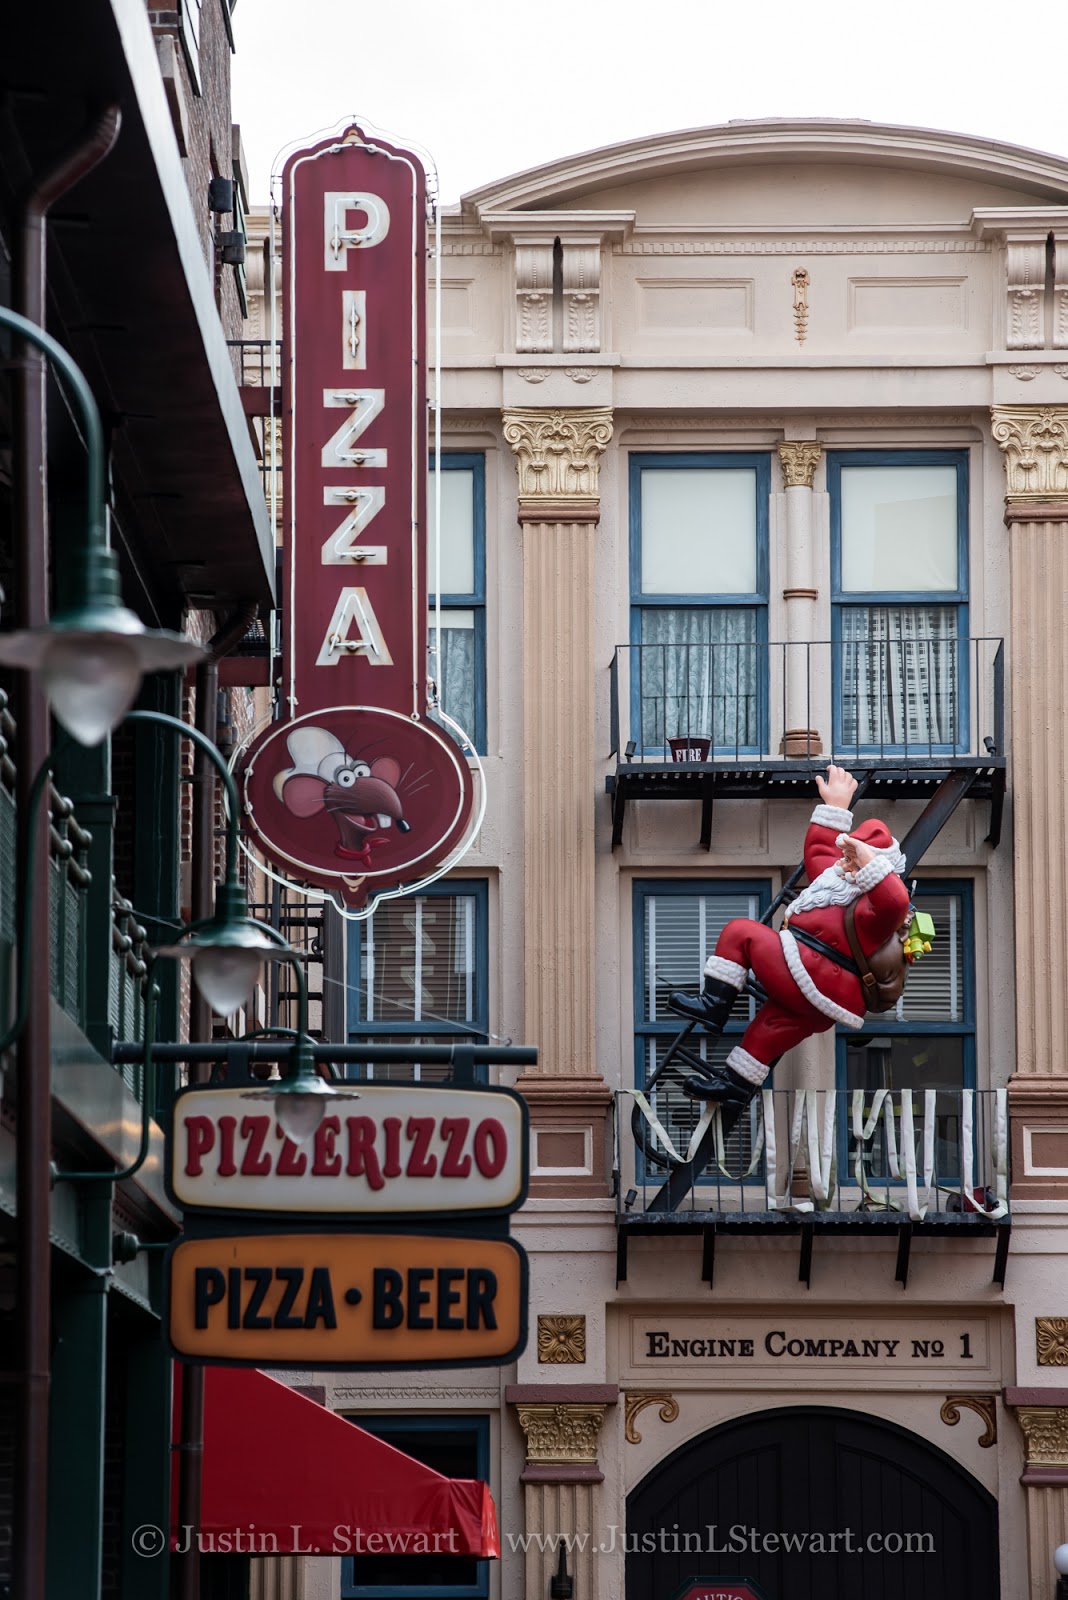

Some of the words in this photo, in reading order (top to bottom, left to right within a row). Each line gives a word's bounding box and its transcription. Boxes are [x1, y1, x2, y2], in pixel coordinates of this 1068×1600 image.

[315, 191, 394, 666] PIZZA
[675, 748, 702, 762] FIRE
[184, 1115, 508, 1191] PIZZERIZZO
[194, 1267, 337, 1330] PIZZA
[373, 1267, 498, 1330] BEER
[959, 1333, 974, 1359] 1
